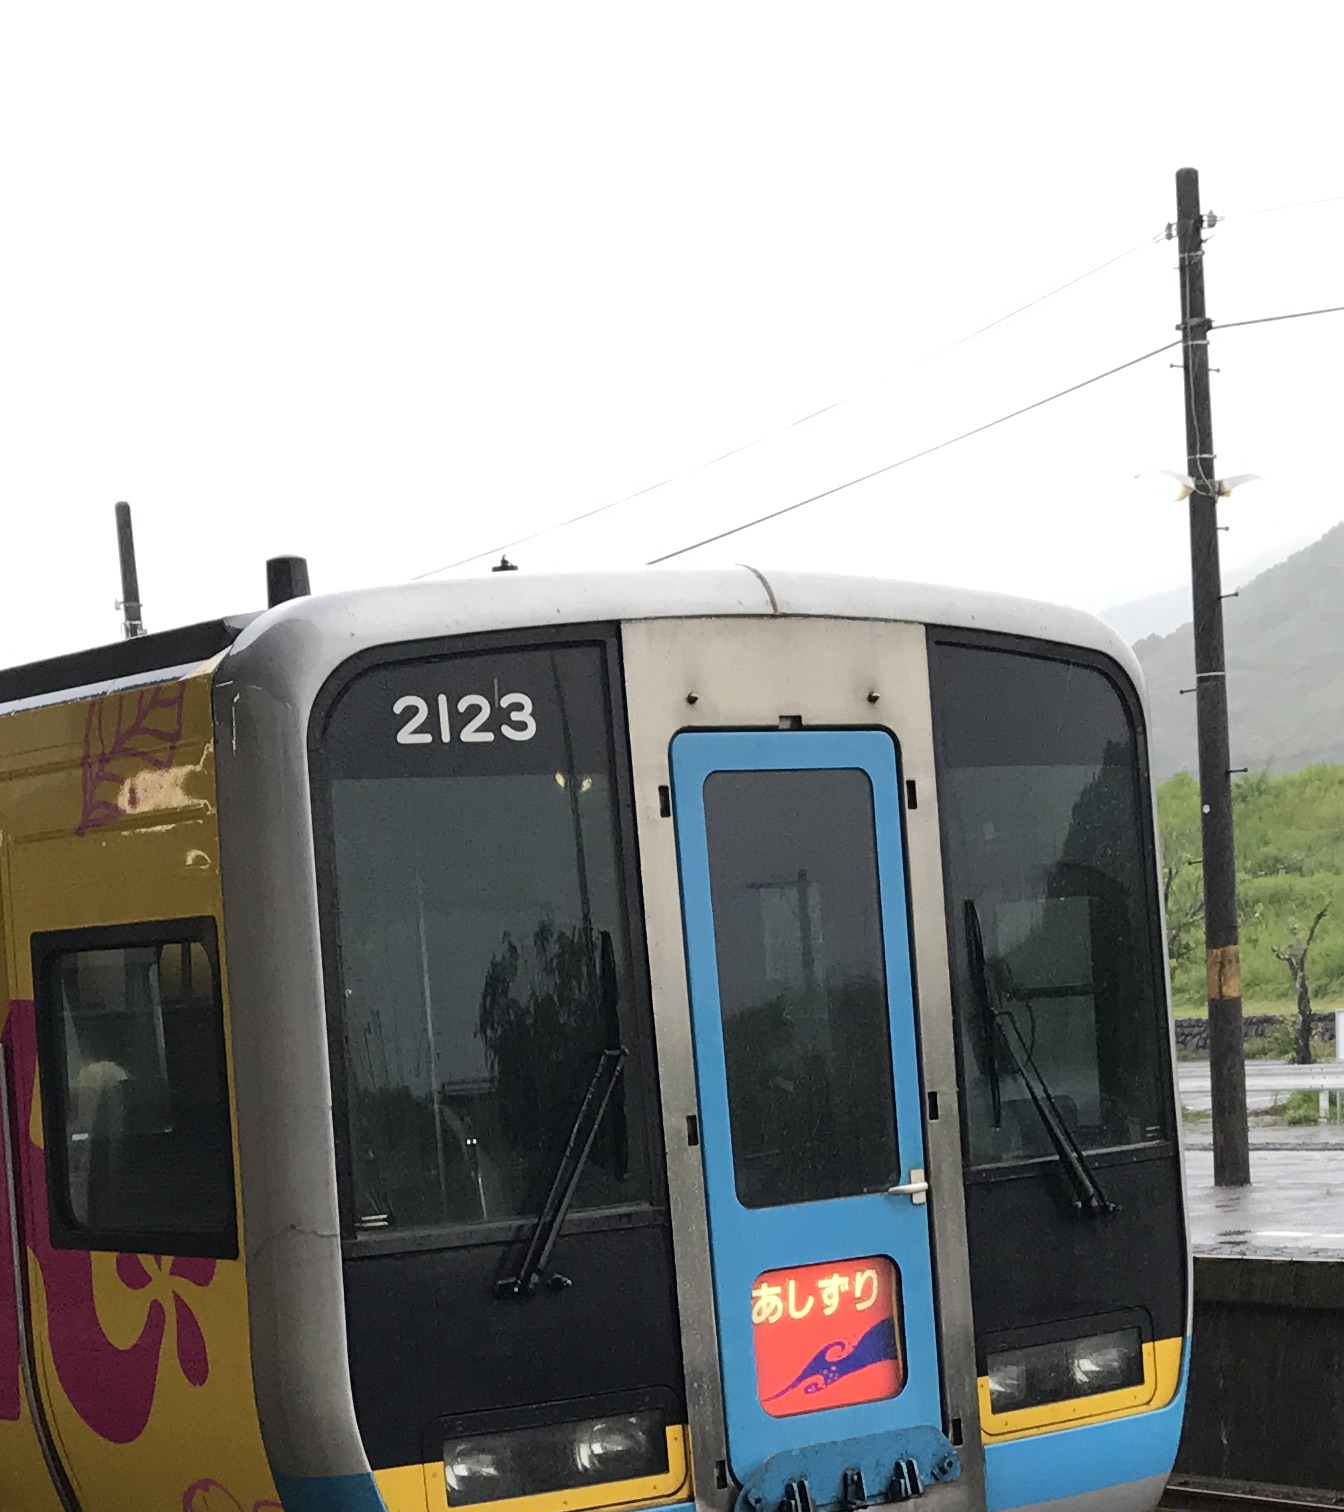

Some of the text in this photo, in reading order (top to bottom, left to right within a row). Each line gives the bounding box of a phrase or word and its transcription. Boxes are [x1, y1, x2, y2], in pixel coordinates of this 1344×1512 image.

[392, 692, 537, 745] 2123
[751, 1268, 879, 1325] あしずり
